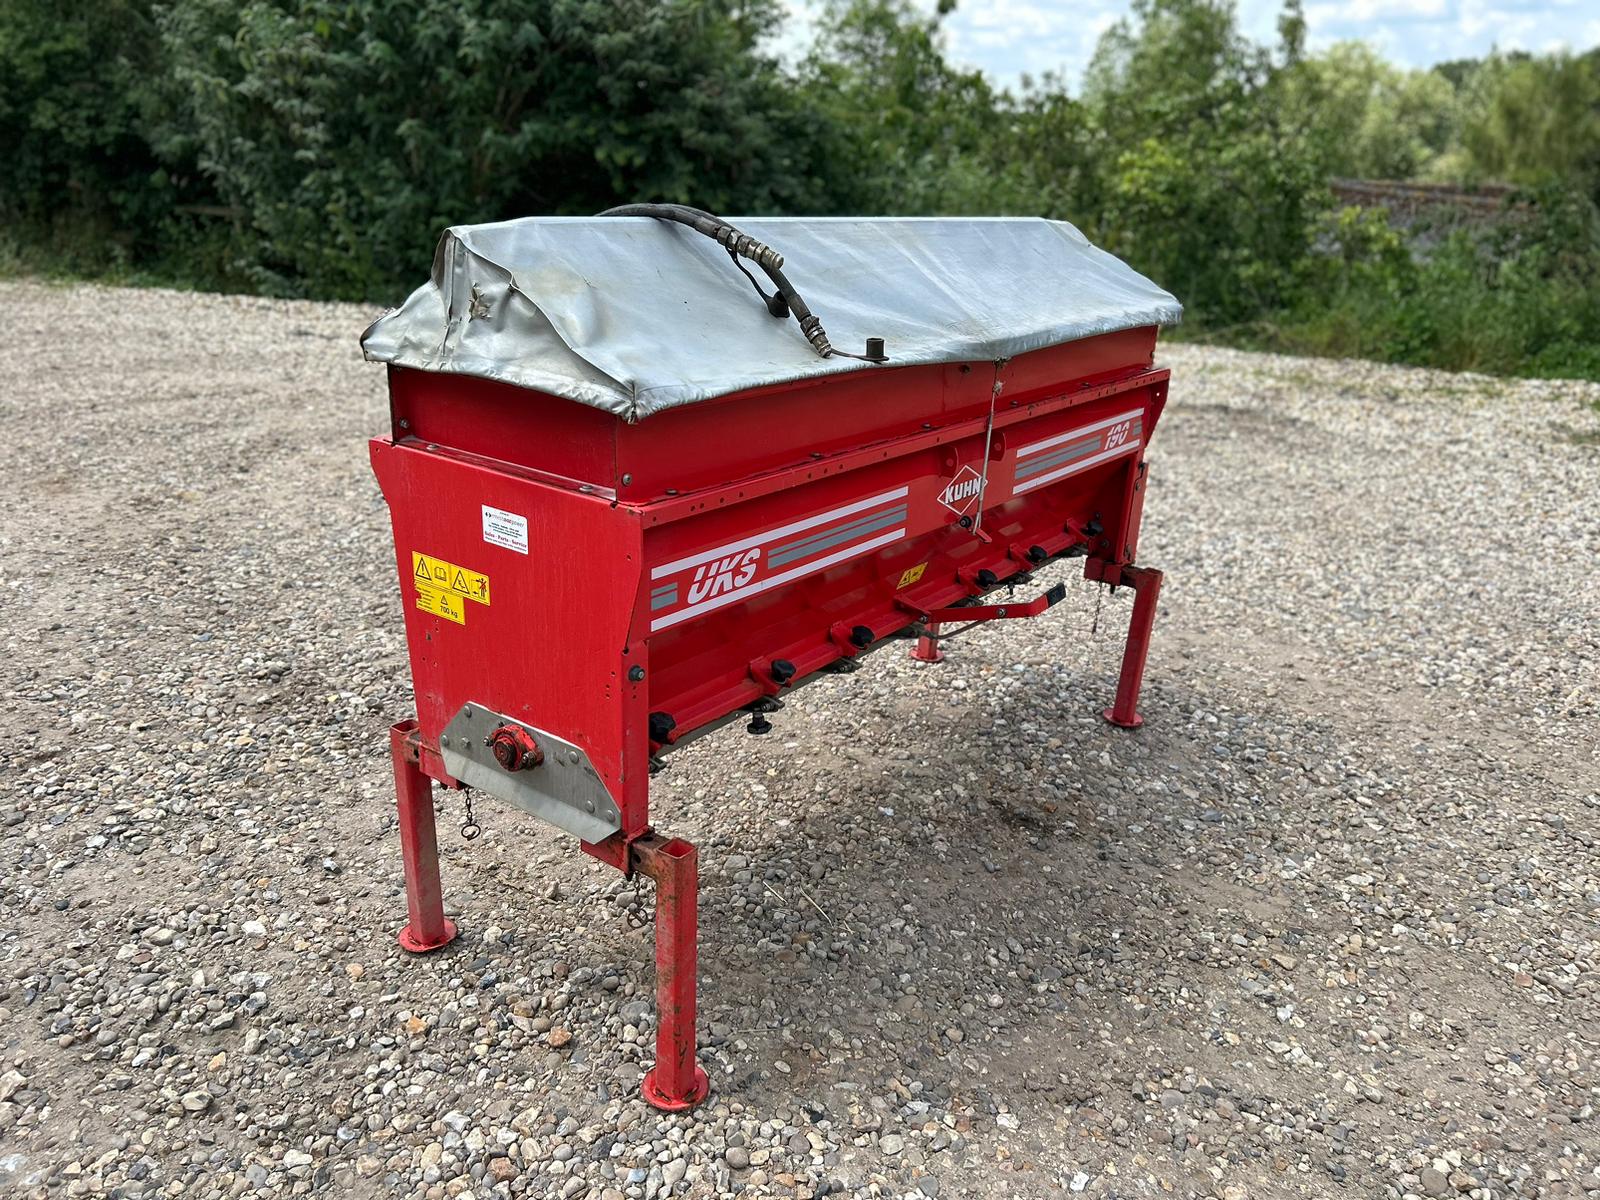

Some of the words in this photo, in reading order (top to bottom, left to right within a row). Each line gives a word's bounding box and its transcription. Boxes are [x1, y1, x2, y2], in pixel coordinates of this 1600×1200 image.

[1104, 421, 1130, 450] 190
[945, 477, 982, 504] KUHN
[687, 547, 761, 605] UKS
[440, 605, 450, 615] 700
[450, 609, 458, 619] kg
